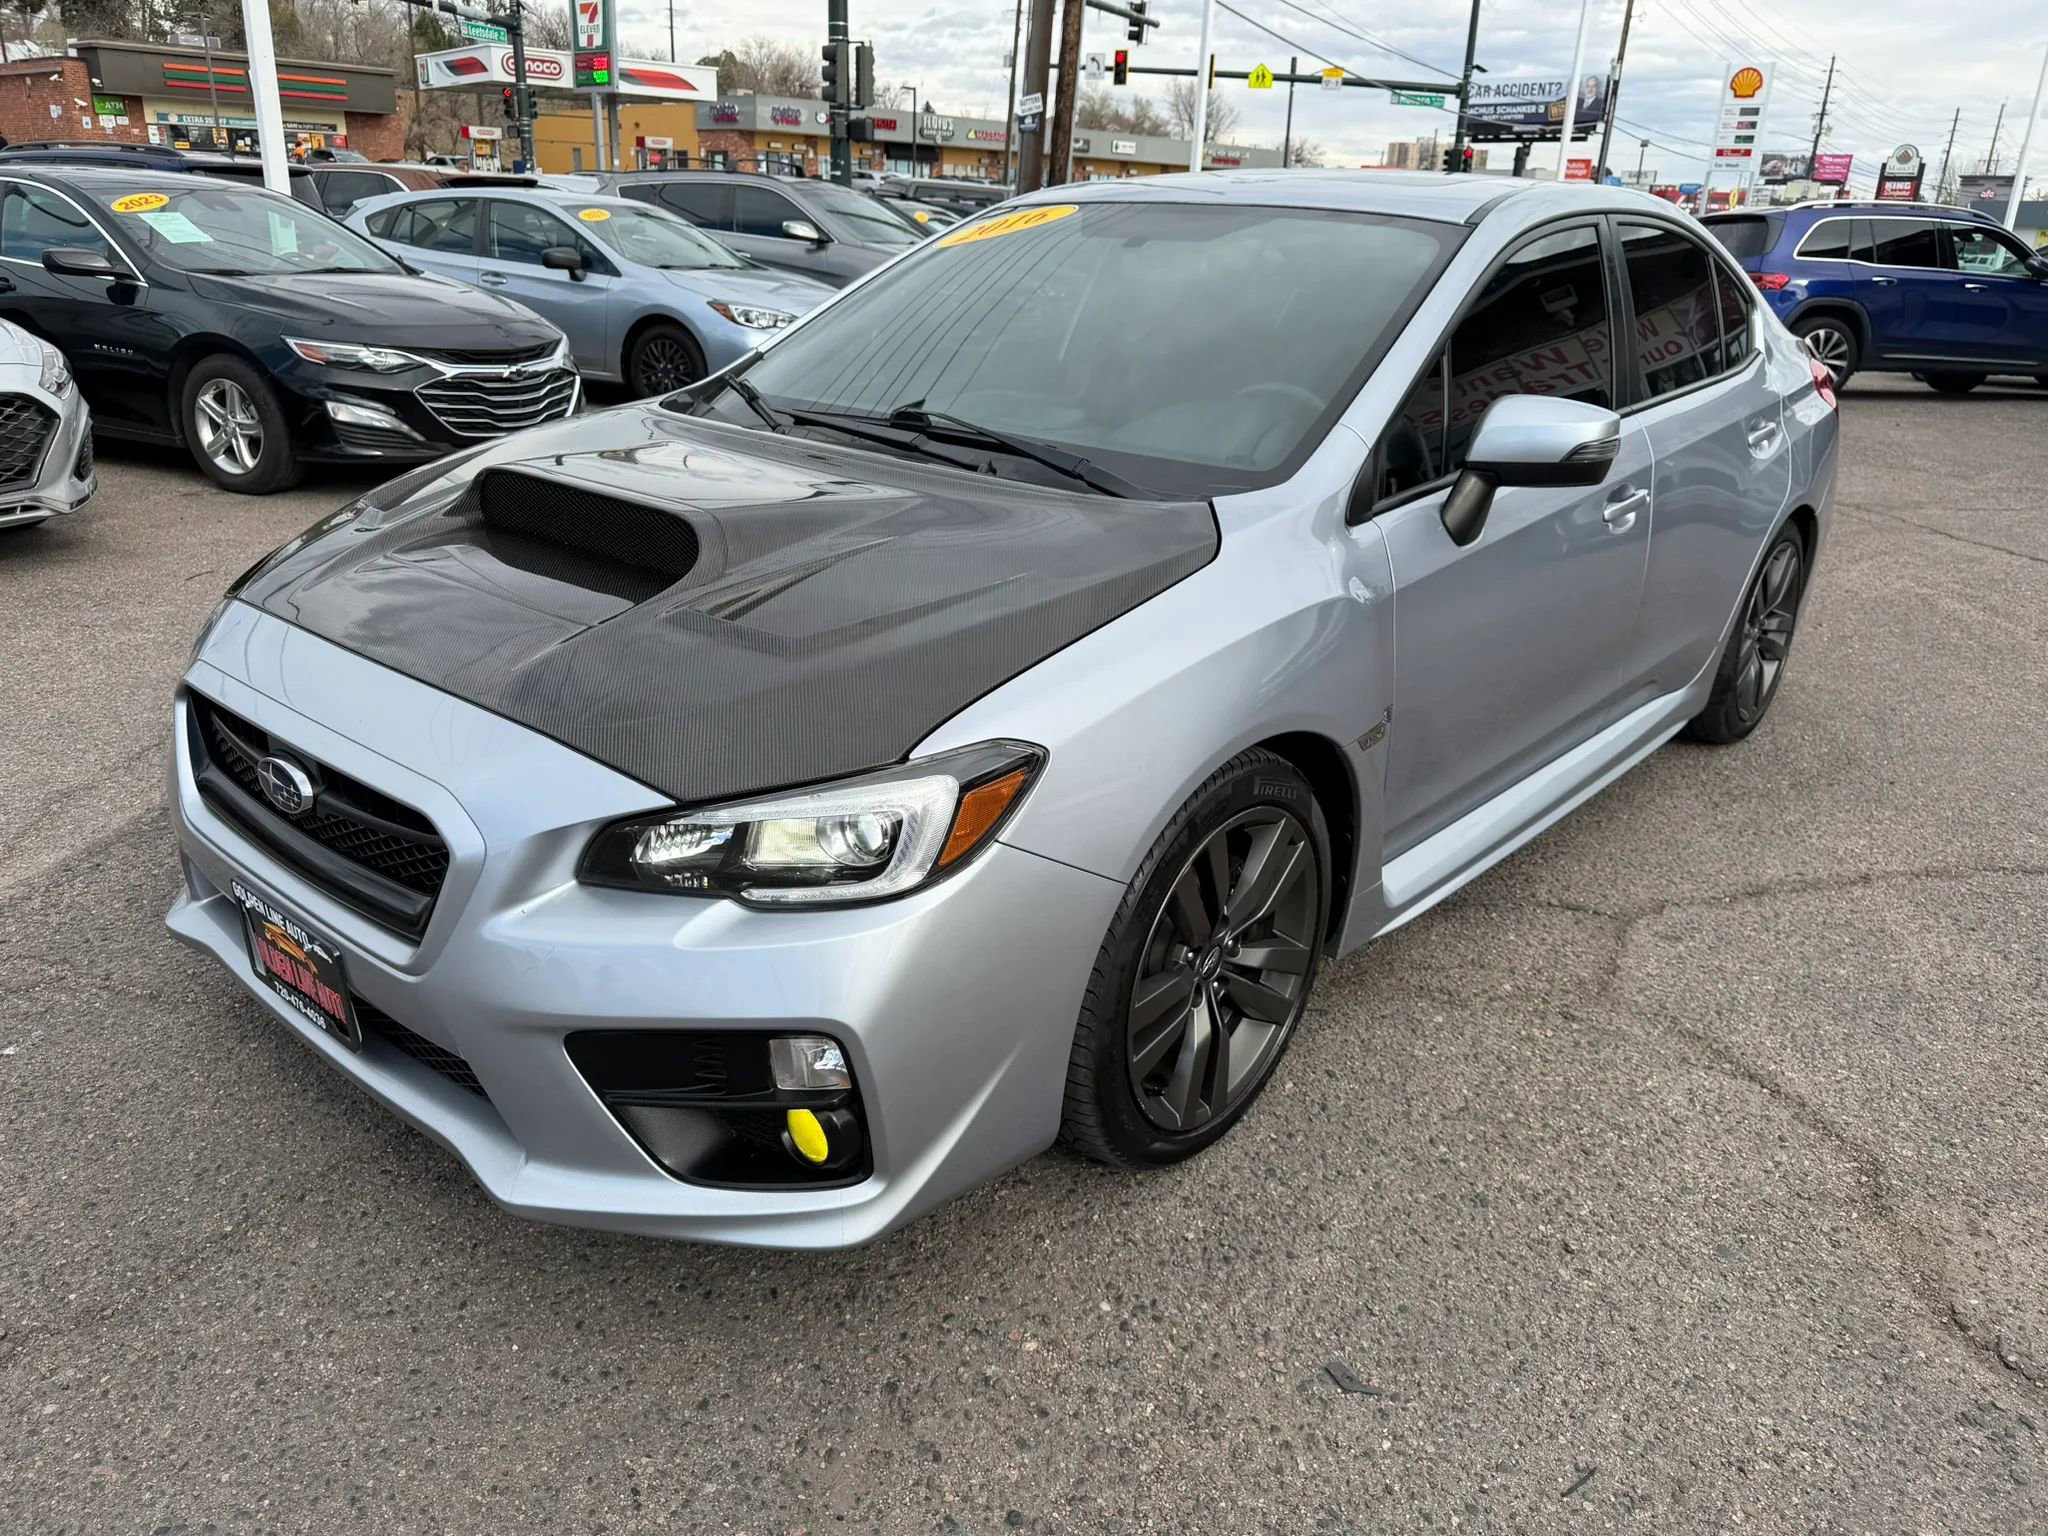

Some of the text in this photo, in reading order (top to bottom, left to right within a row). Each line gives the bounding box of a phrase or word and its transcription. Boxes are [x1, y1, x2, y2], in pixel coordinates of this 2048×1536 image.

[469, 25, 499, 40] Leetsdale
[579, 1, 599, 48] 7
[1468, 82, 1562, 98] CAR ACCIDENT?
[105, 101, 123, 109] ATM
[1468, 105, 1494, 114] ACHUS
[1885, 181, 1911, 190] KING
[119, 194, 164, 211] 2023
[93, 343, 133, 356] MALIBU
[1252, 775, 1297, 799] PIRELLI
[232, 881, 309, 946] GOLDEN LINE AUTO
[254, 935, 347, 1025] OLDEN LINE AUTO
